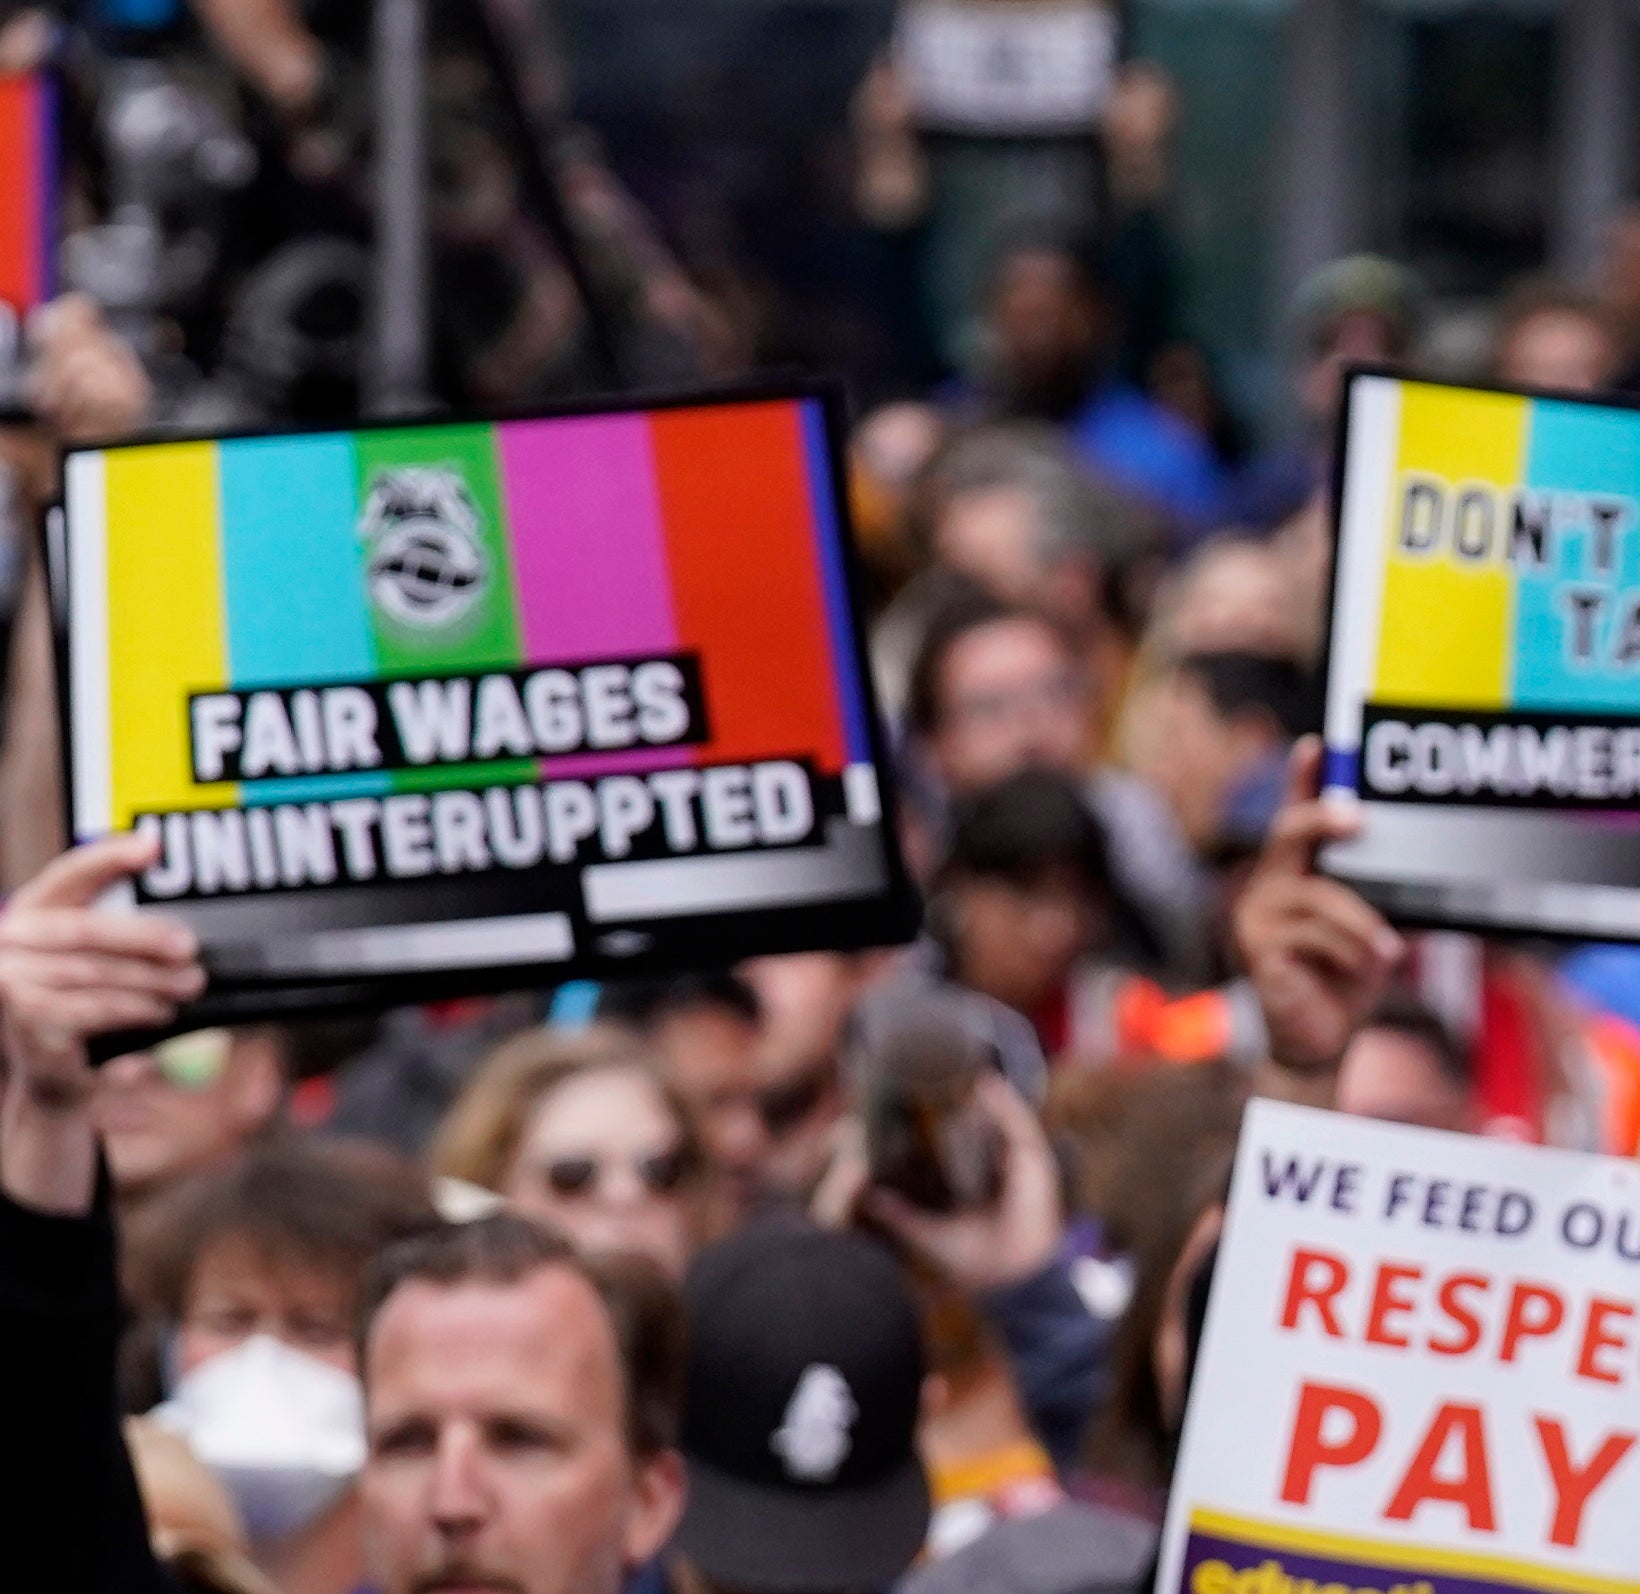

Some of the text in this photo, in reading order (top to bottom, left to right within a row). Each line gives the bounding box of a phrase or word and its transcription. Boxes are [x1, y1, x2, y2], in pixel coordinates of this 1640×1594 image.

[1400, 479, 1630, 573] DON'T
[191, 663, 690, 782] FAIR WAGES
[140, 763, 813, 898] UNINTERUPPTED
[1260, 1149, 1362, 1211] WE
[1385, 1174, 1534, 1238] FEED
[1279, 1381, 1640, 1548] PAY
